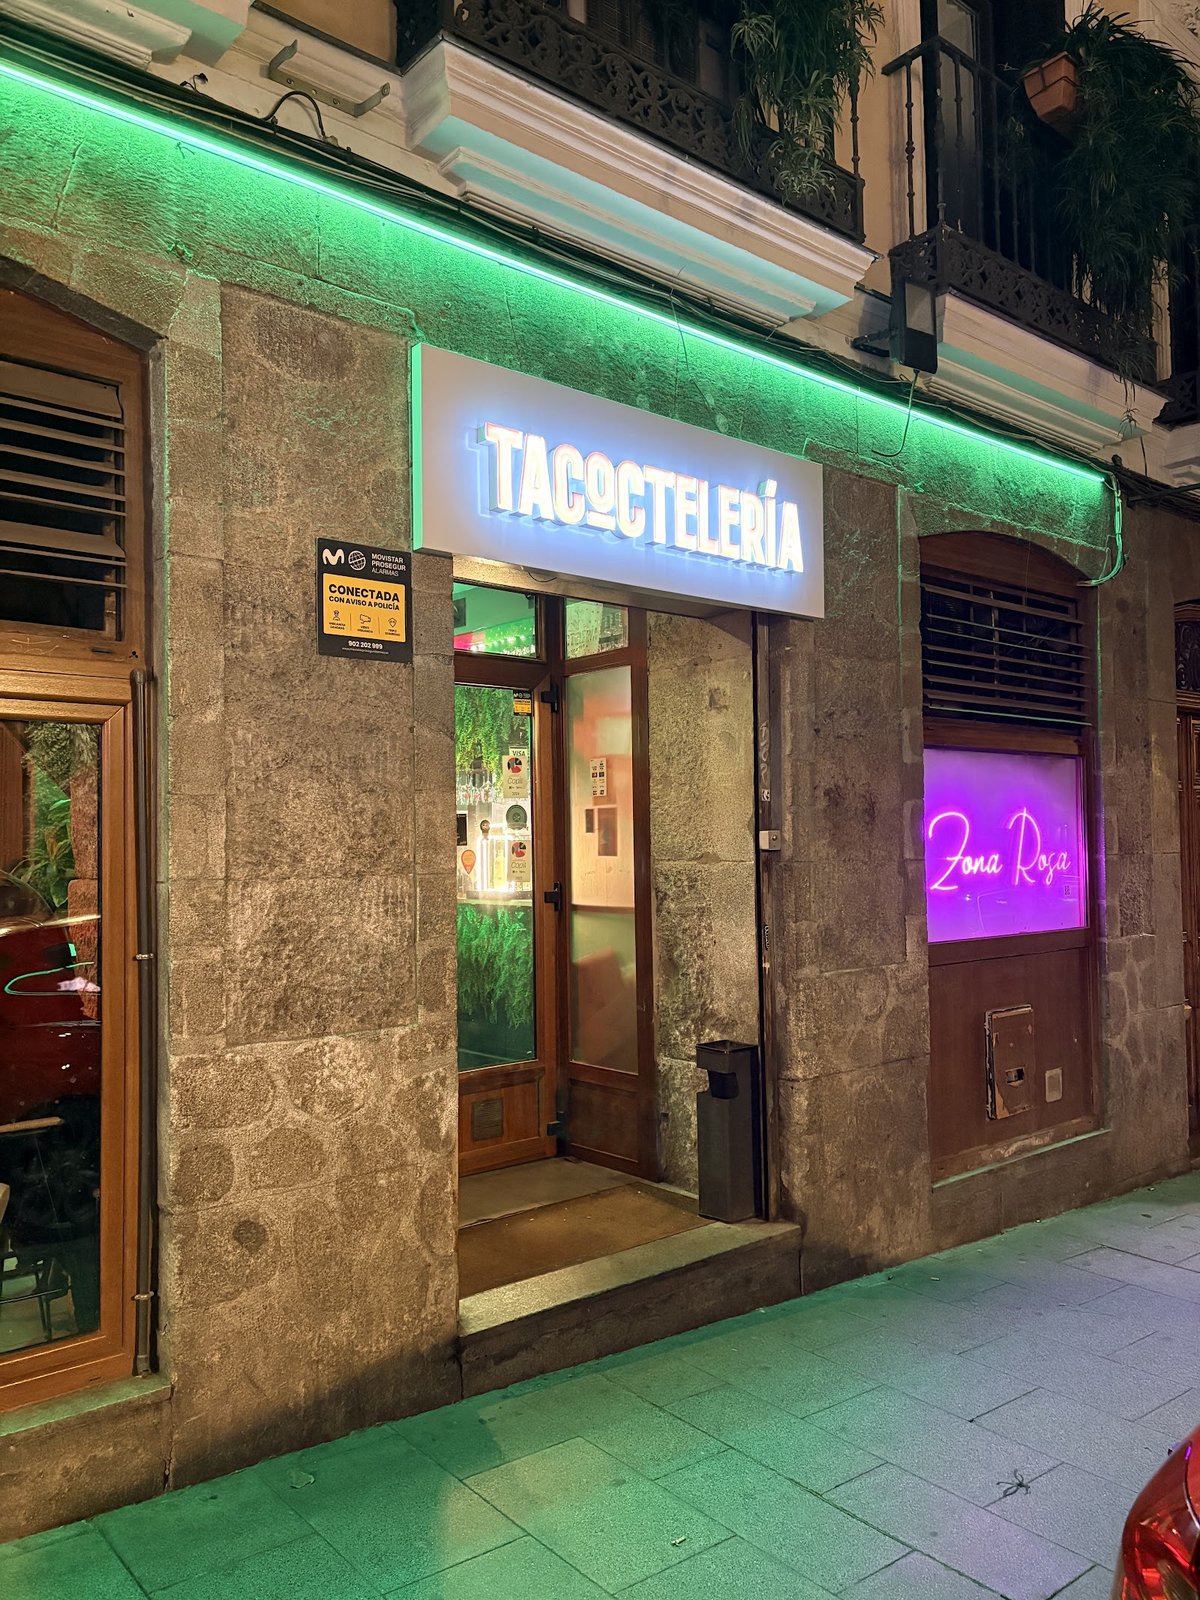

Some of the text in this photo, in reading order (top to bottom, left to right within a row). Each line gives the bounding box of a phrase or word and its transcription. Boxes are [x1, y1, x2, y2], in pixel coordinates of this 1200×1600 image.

[482, 422, 804, 573] TACOCTELERÍA
[371, 553, 404, 564] MOVISTAR
[371, 560, 406, 572] PROSEGUR
[371, 567, 399, 577] ALARMAS
[328, 584, 400, 603] CONECTADA
[328, 595, 345, 604] CON
[345, 598, 367, 607] AVISO
[373, 601, 400, 611] POLICÍA
[928, 807, 1071, 890] Zona Rosa
